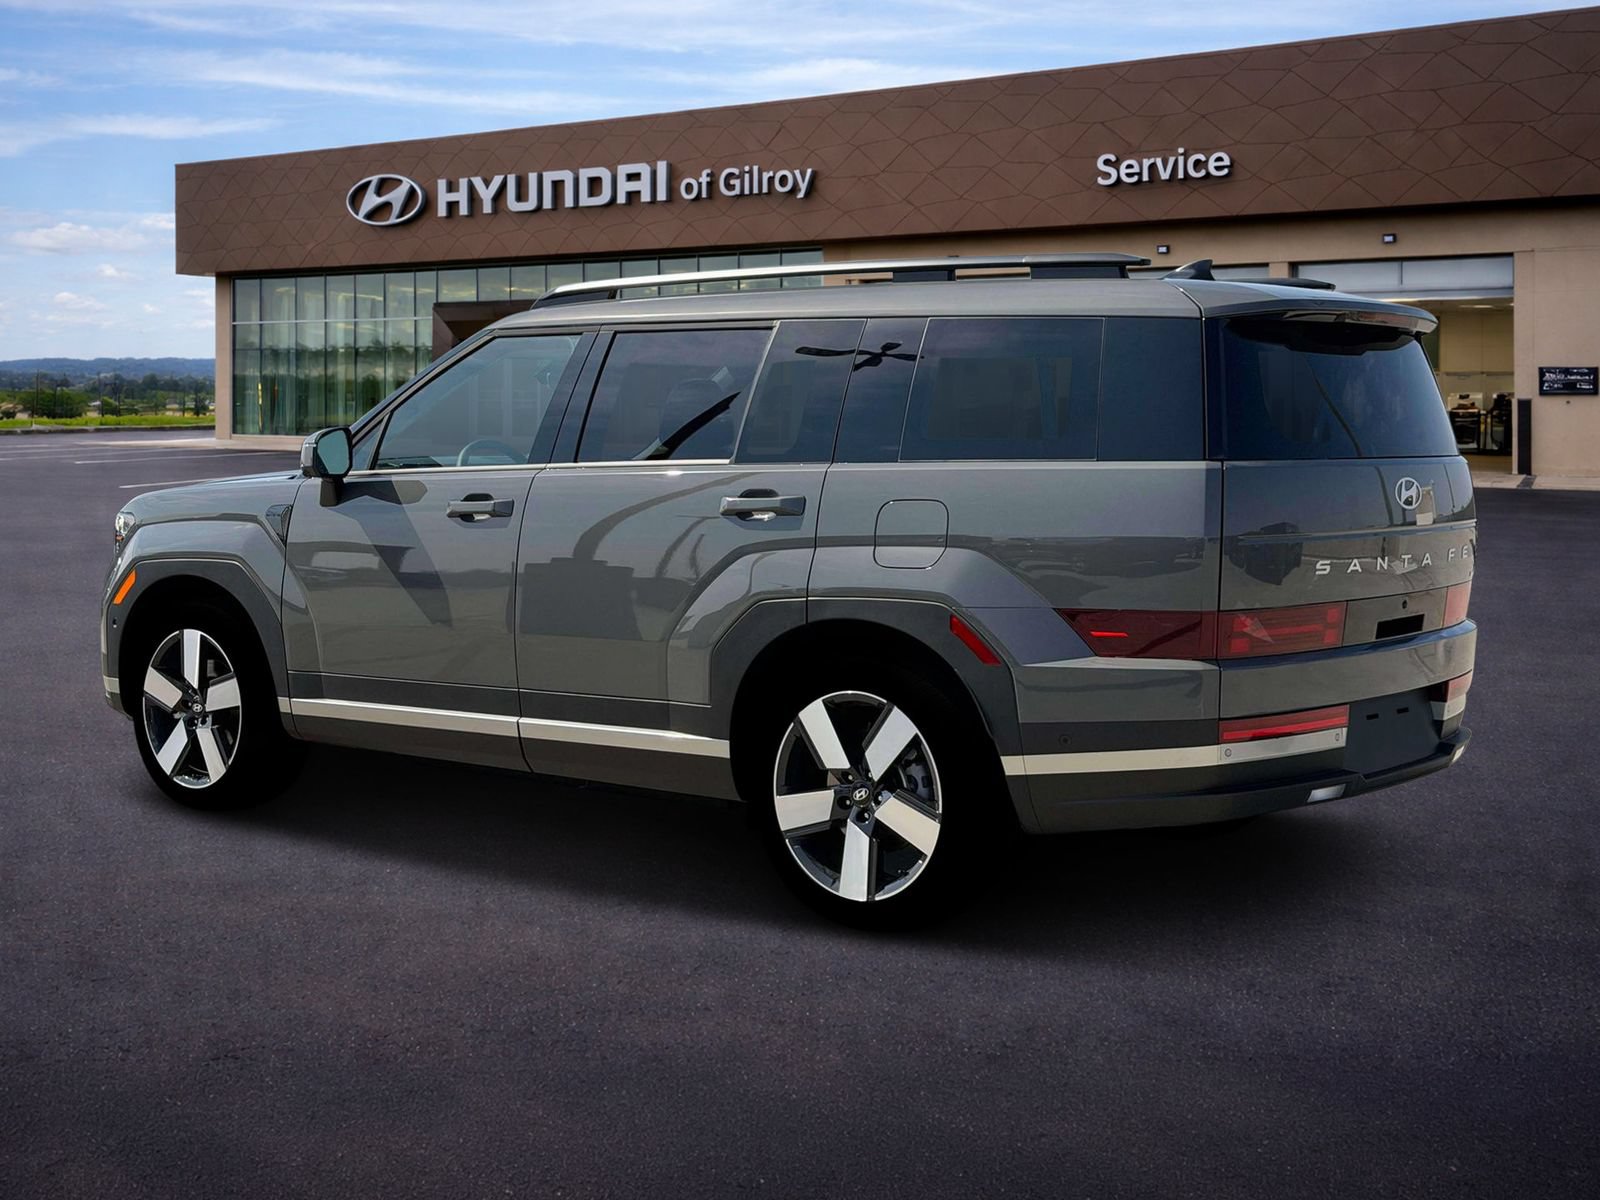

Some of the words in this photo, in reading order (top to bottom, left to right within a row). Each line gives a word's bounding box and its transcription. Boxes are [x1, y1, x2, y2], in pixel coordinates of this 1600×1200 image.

[1096, 147, 1231, 186] Service
[437, 160, 670, 218] HYUNDAI
[680, 170, 713, 200] of
[718, 165, 814, 199] Gilroy
[1315, 552, 1433, 575] SANTA
[1448, 545, 1469, 563] FE
